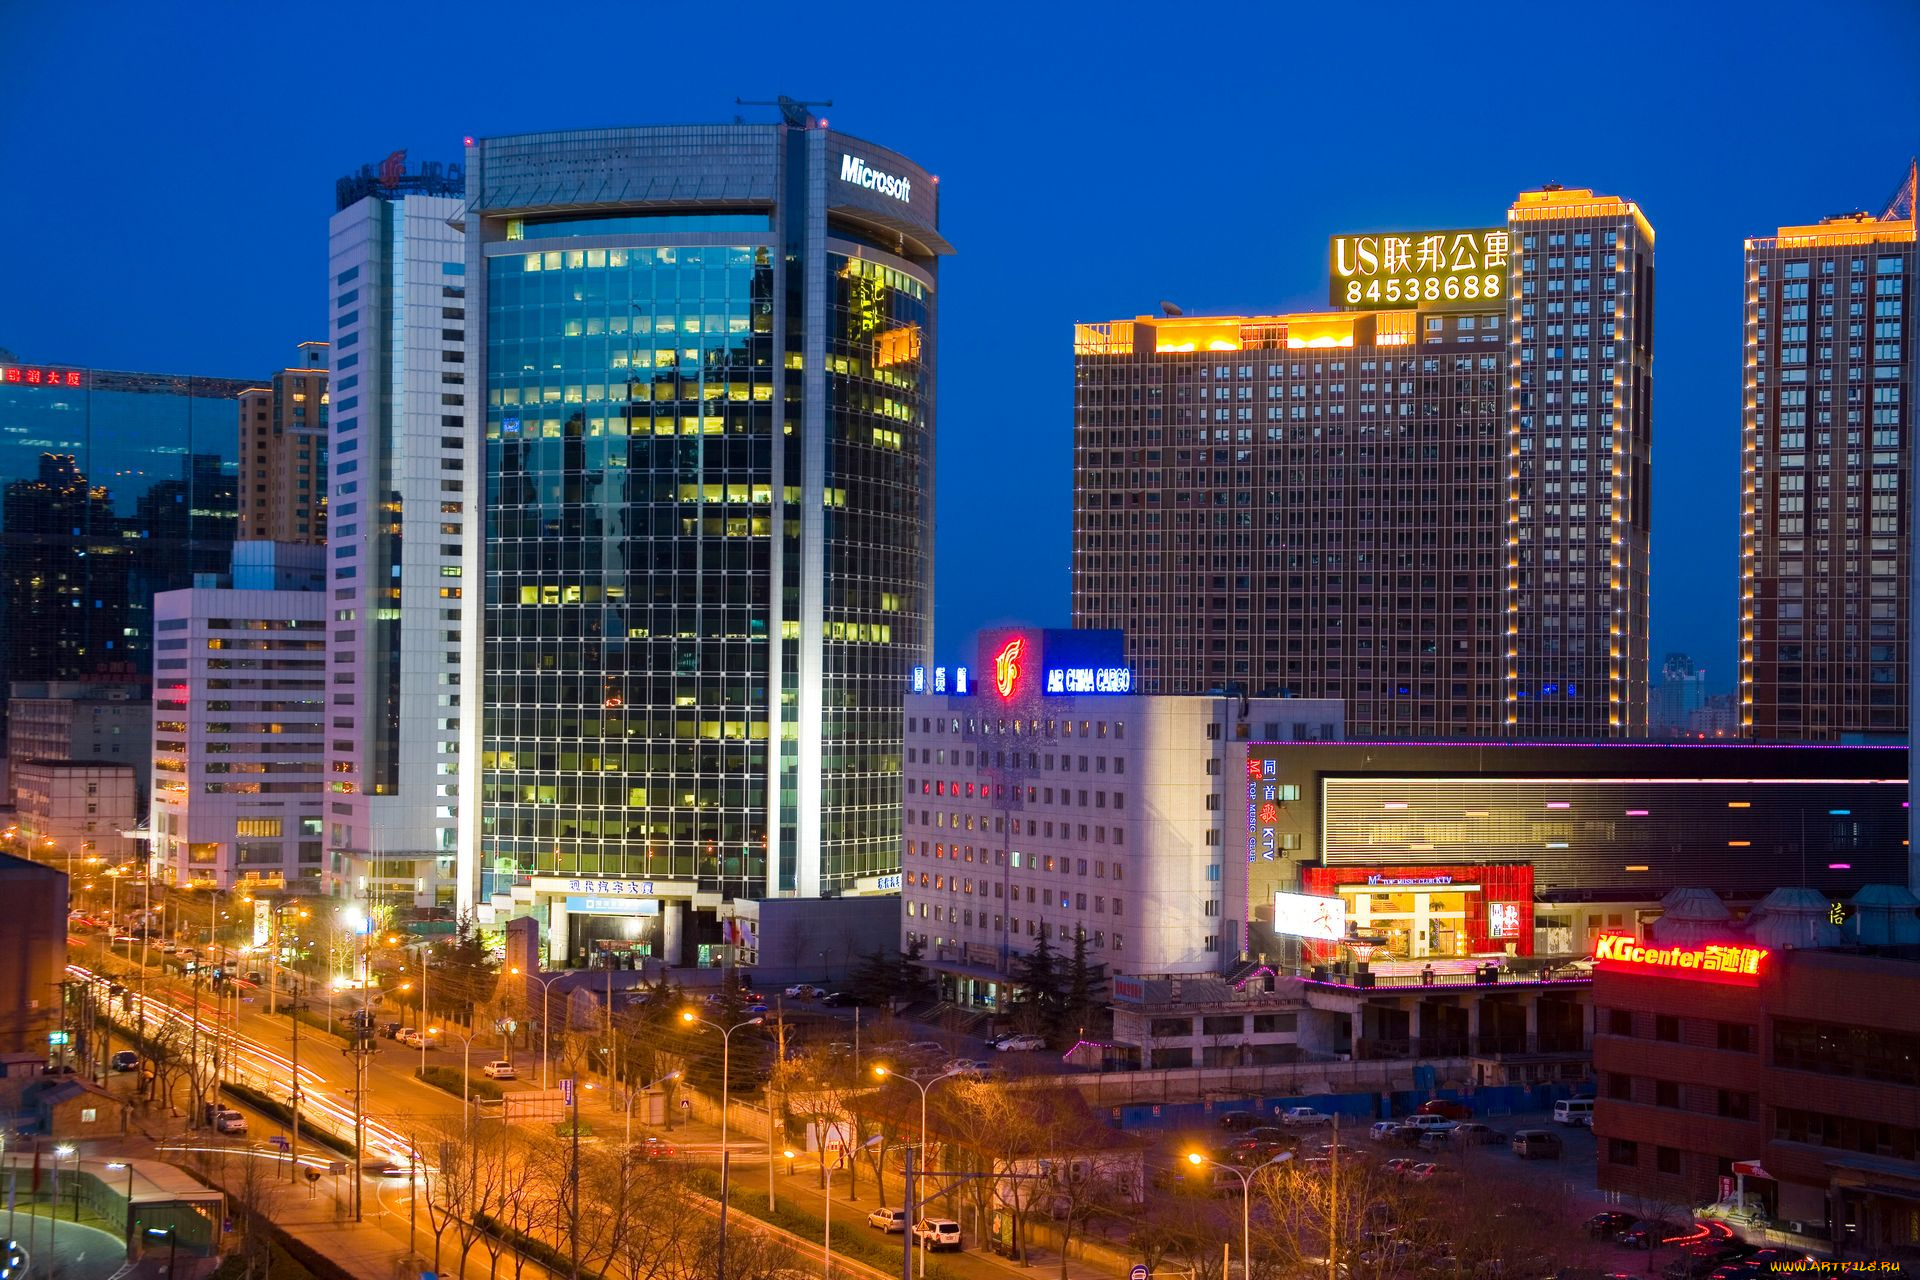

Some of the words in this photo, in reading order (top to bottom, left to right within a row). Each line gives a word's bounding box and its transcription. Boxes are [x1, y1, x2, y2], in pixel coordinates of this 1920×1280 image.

[840, 154, 911, 203] Microsoft
[1335, 237, 1379, 276] US
[1384, 230, 1509, 275] 联邦公寓
[1346, 274, 1500, 303] 84538688
[1047, 669, 1064, 692] AIR
[1065, 668, 1095, 692] CHINA
[1096, 668, 1130, 692] CARGO
[1249, 781, 1257, 800] TOP
[1249, 804, 1257, 833] MUSIC
[1249, 837, 1257, 863] CLUB
[1262, 828, 1275, 861] KTV
[569, 879, 654, 895] 现代汽车大厦
[1435, 876, 1452, 885] KTV
[1595, 934, 1704, 969] KGcenter
[1703, 944, 1769, 975] 奇迹健
